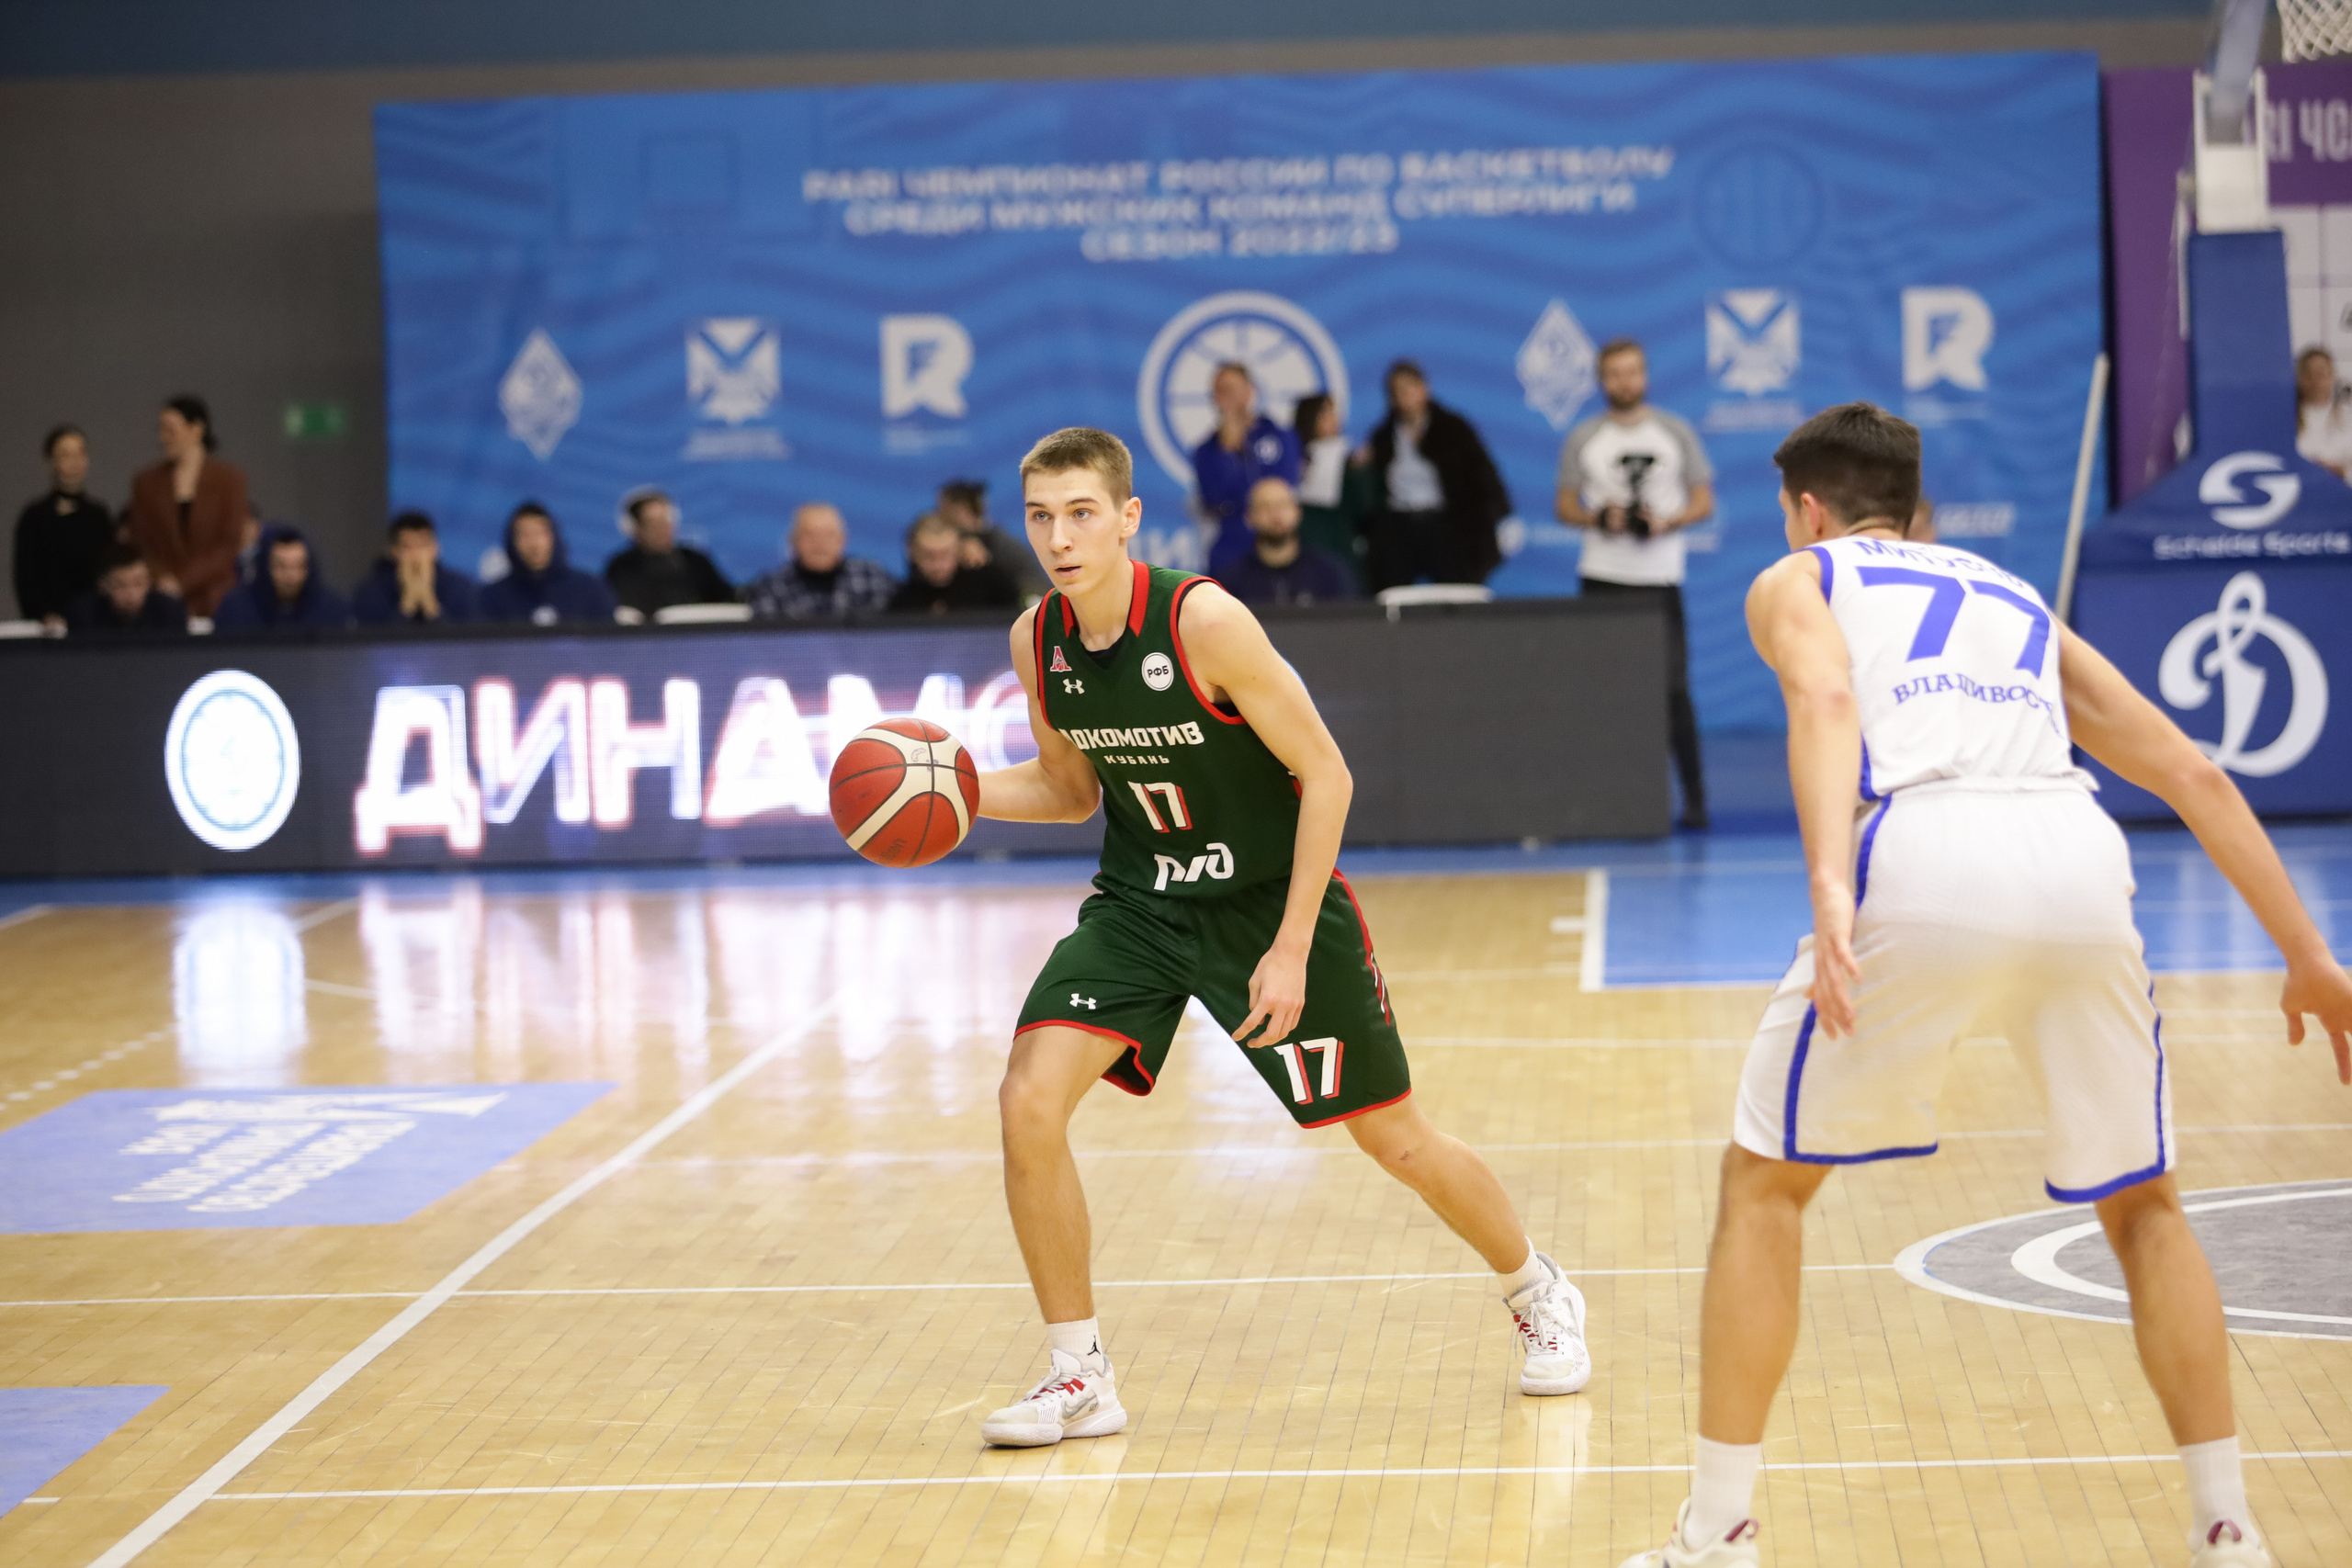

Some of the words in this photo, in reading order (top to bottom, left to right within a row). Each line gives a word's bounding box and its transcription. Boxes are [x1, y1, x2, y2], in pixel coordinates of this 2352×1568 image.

[1159, 155, 1328, 194] РОССИИ
[1334, 152, 1395, 187] ПО
[1855, 566, 2050, 680] 77
[1147, 665, 1170, 678] РФБ
[1103, 754, 1170, 765] КУБАНЬ
[1127, 781, 1193, 833] 17
[1273, 1036, 1344, 1105] 17
